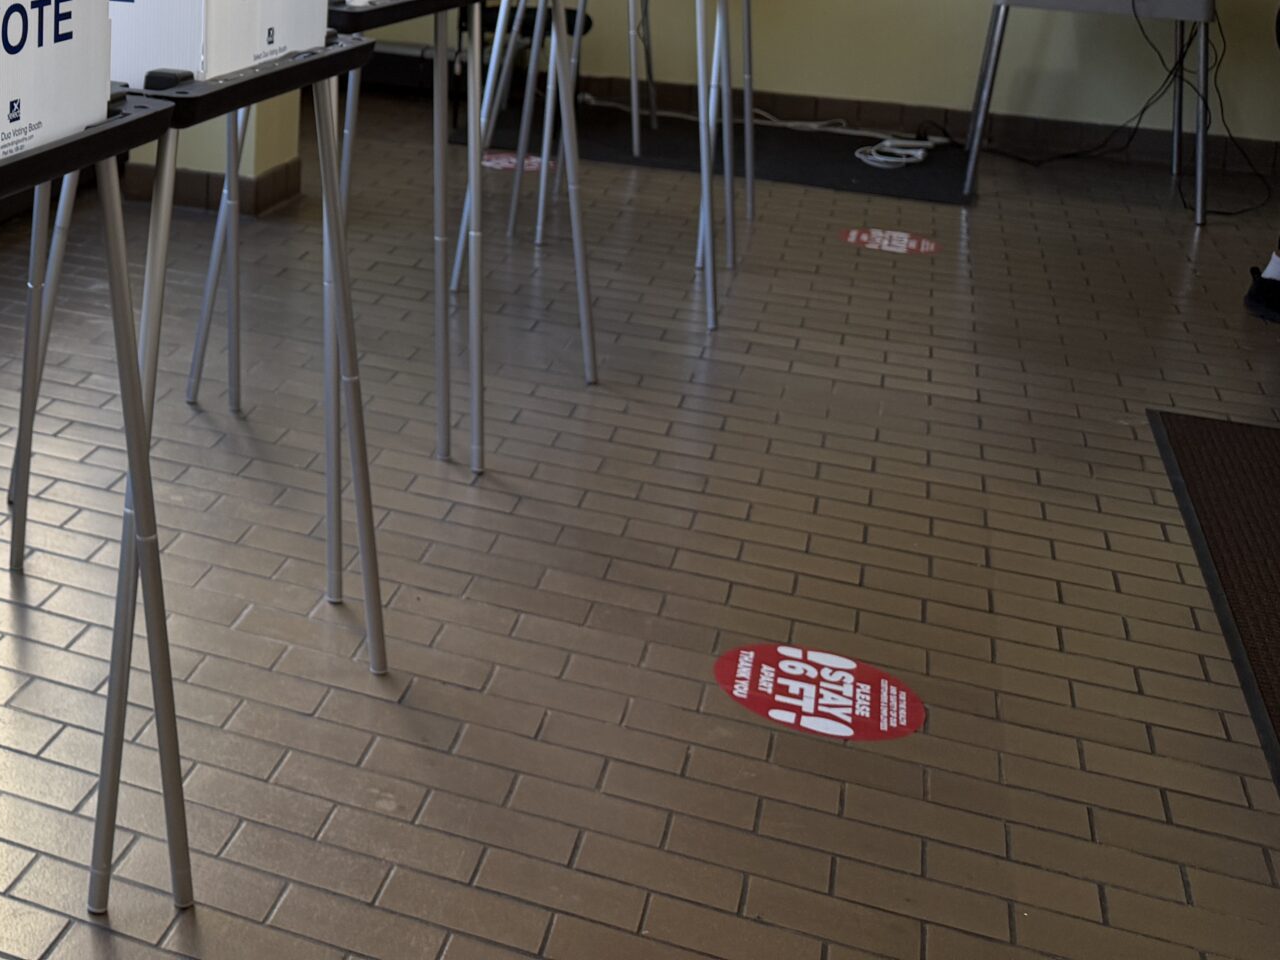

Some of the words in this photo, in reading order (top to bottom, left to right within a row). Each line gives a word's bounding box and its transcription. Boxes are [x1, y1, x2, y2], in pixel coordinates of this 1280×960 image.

[735, 650, 755, 679] THANK
[758, 664, 776, 695] APART
[778, 659, 818, 679] 6
[732, 678, 749, 699] YOU
[775, 677, 817, 714] FT
[817, 667, 855, 724] STAY
[855, 682, 871, 718] PLEASE
